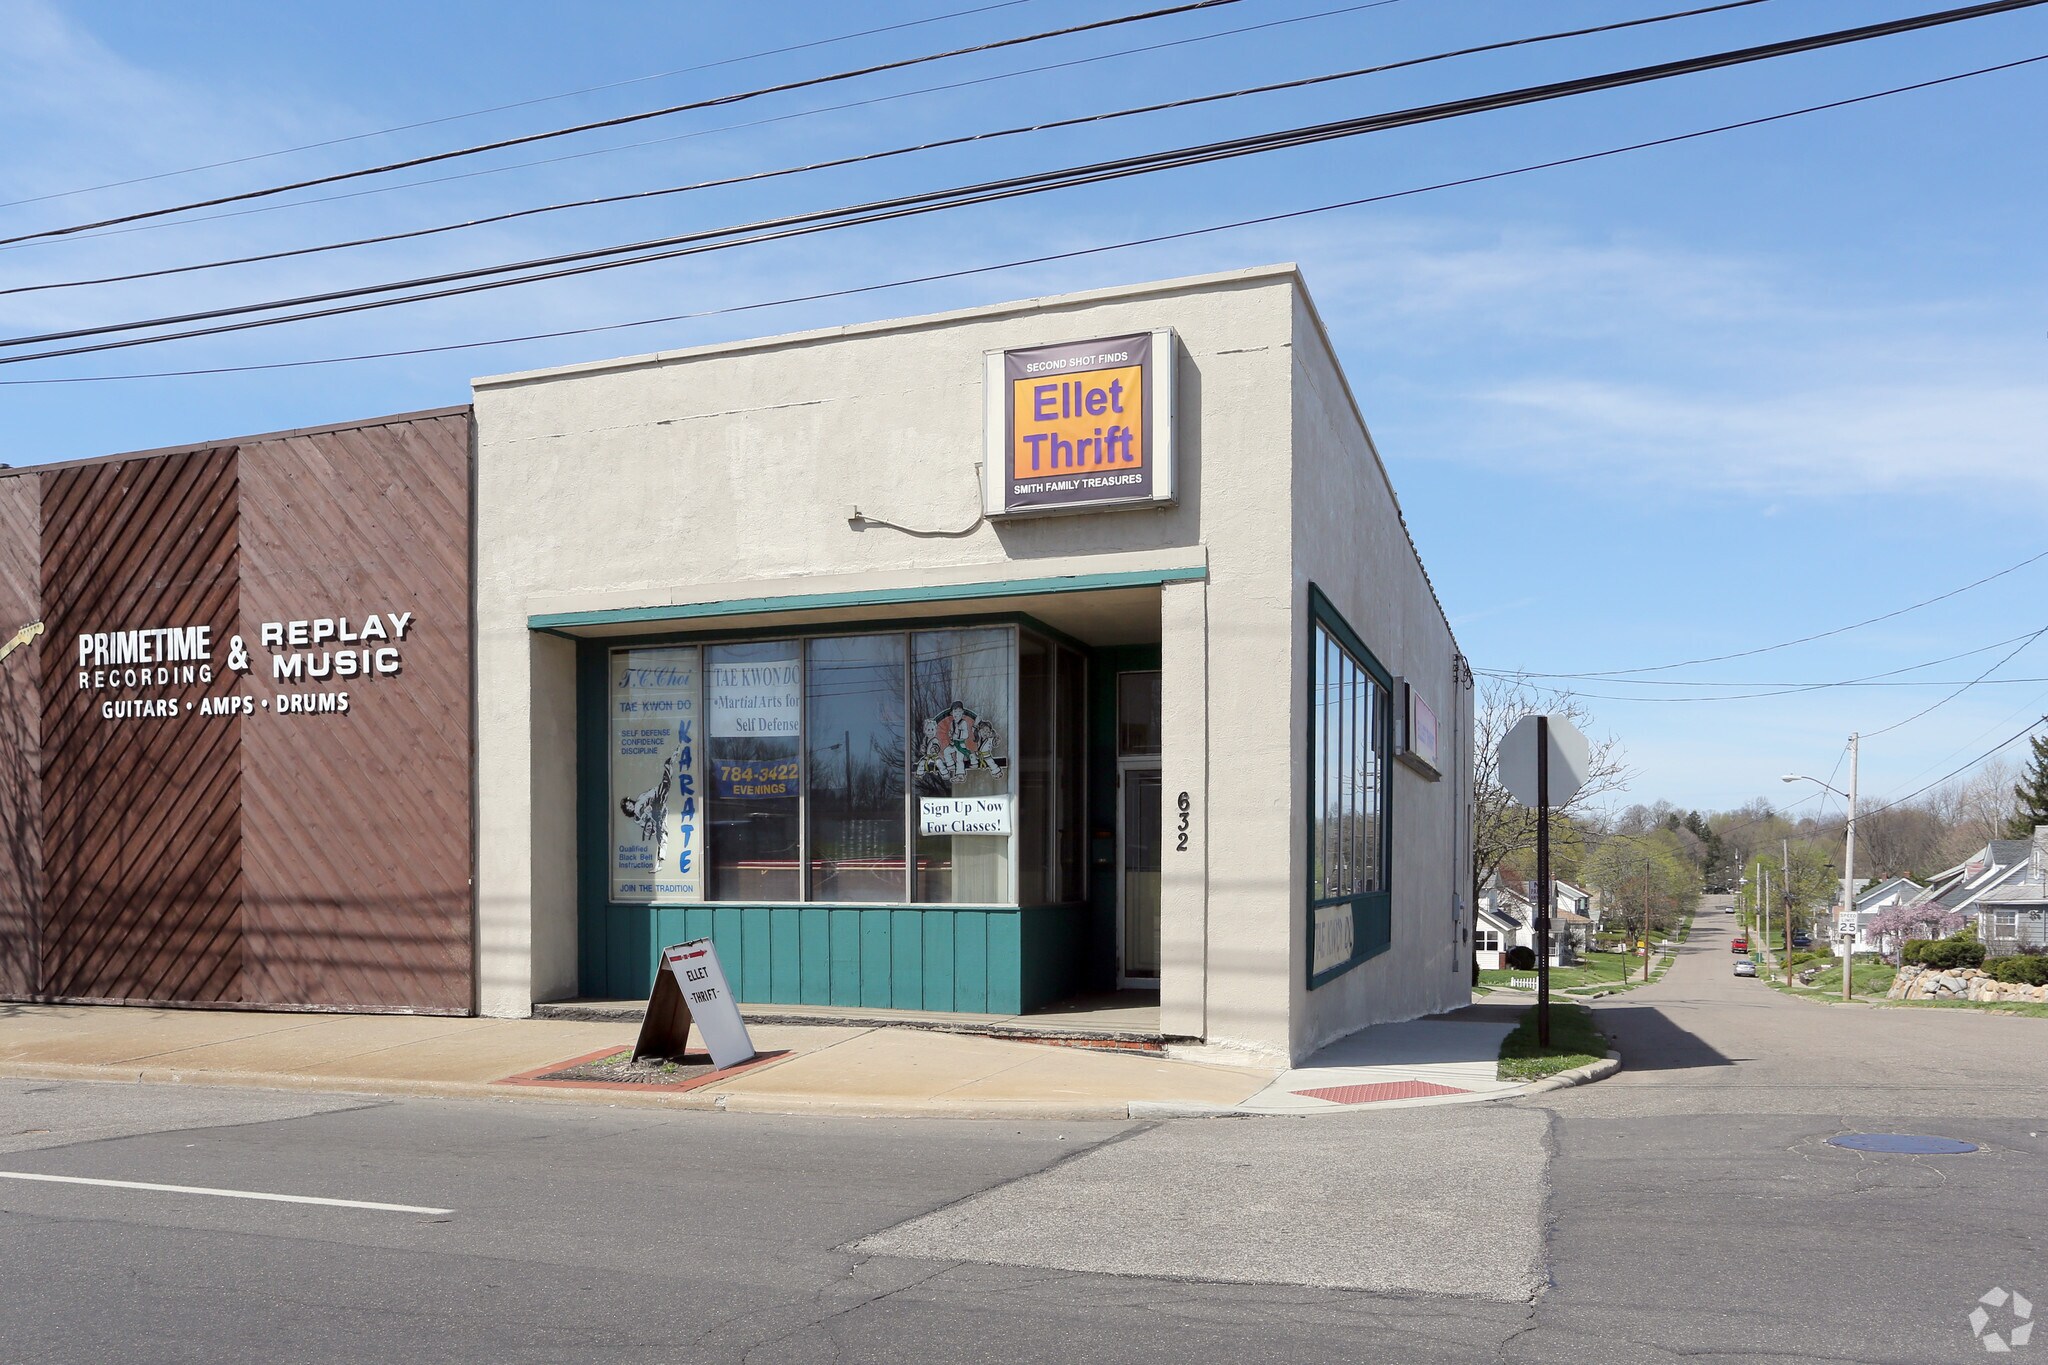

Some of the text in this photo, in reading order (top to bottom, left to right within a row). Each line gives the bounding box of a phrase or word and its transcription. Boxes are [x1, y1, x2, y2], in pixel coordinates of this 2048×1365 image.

[1026, 352, 1129, 373] SECOND SHOT FINDS
[1034, 378, 1124, 421] Ellet
[1023, 426, 1134, 471] Thrift
[1014, 474, 1143, 495] SMITH FAMILY TREASURES
[261, 612, 412, 646] REPLAY
[79, 626, 211, 667] PRIMETIME
[227, 635, 249, 671] &
[272, 648, 399, 678] MUSIC
[79, 665, 212, 689] RECORDING
[714, 668, 739, 687] TAE
[742, 667, 782, 687] KWON
[102, 692, 349, 719] GUITARS AMPS DRUMS
[619, 700, 692, 712] TAE KWON DO
[718, 695, 757, 709] Martial
[759, 696, 782, 708] Arts
[736, 718, 798, 731] Self Defense
[621, 747, 658, 755] DISCIPLINE
[721, 764, 798, 782] 784-3422
[678, 720, 694, 874] KARATE
[733, 784, 786, 795] EVENINGS
[923, 800, 1004, 817] Sign Up Now
[926, 819, 1001, 833] For Classes!
[1176, 791, 1190, 851] 632
[619, 845, 648, 853] Qualified
[620, 885, 694, 893] JOIN THE TRADITION
[1840, 923, 1856, 932] 25
[686, 966, 709, 982] ELLET
